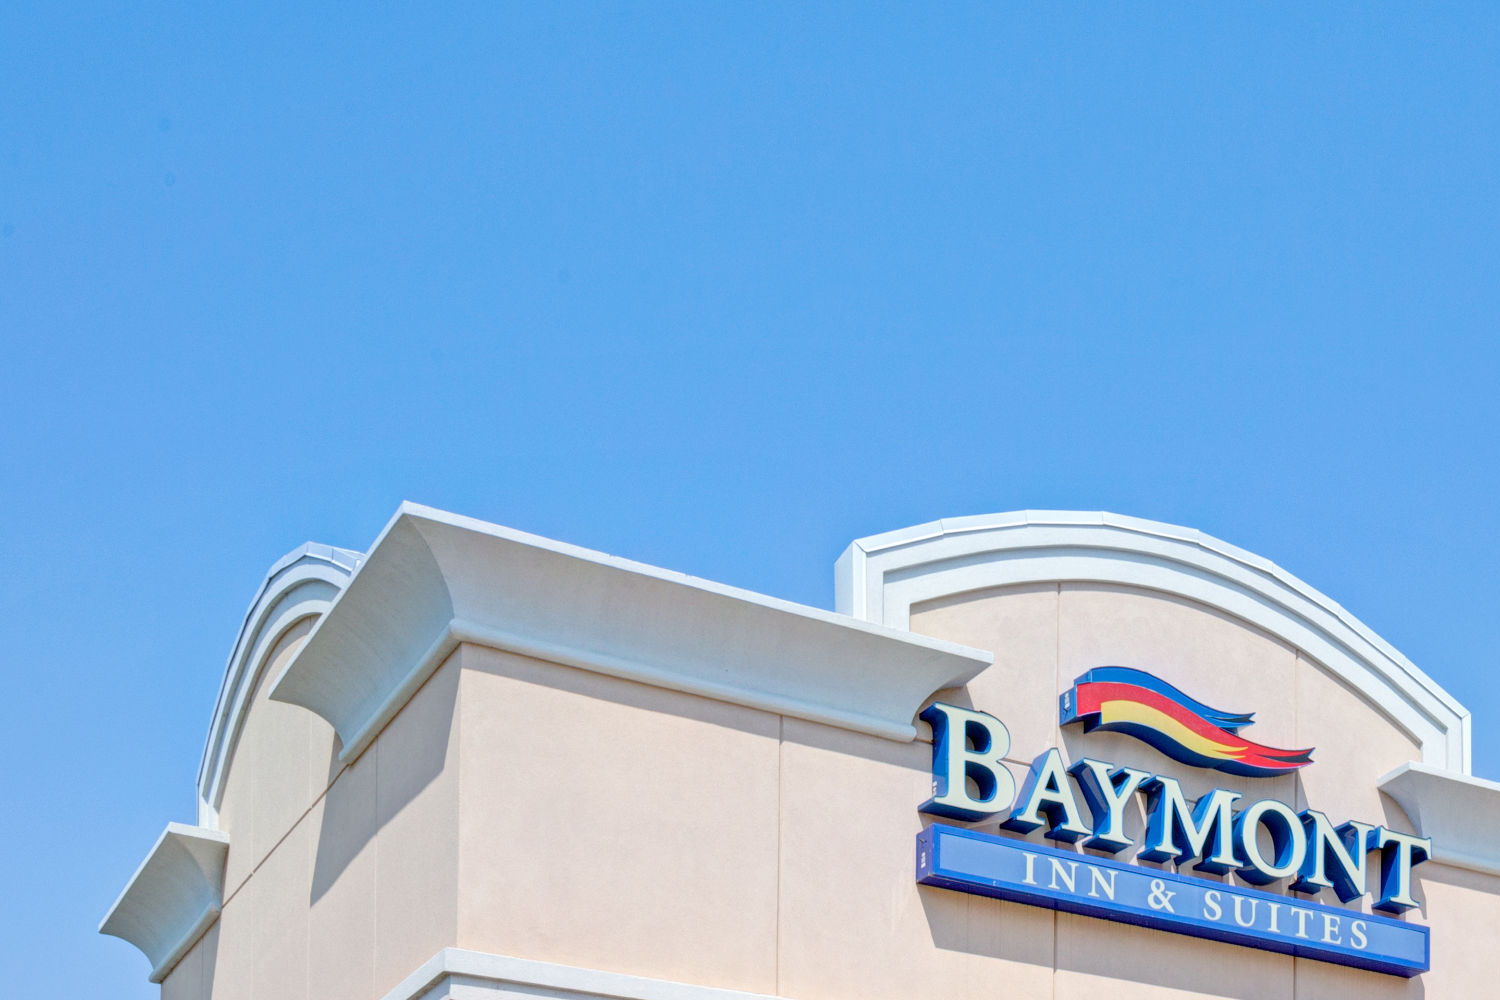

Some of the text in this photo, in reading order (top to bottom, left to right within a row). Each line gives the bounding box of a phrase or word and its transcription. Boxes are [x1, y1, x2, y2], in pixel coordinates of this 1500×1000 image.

[931, 701, 1432, 909] BAYMONT
[1022, 852, 1368, 949] INN & SUITES
